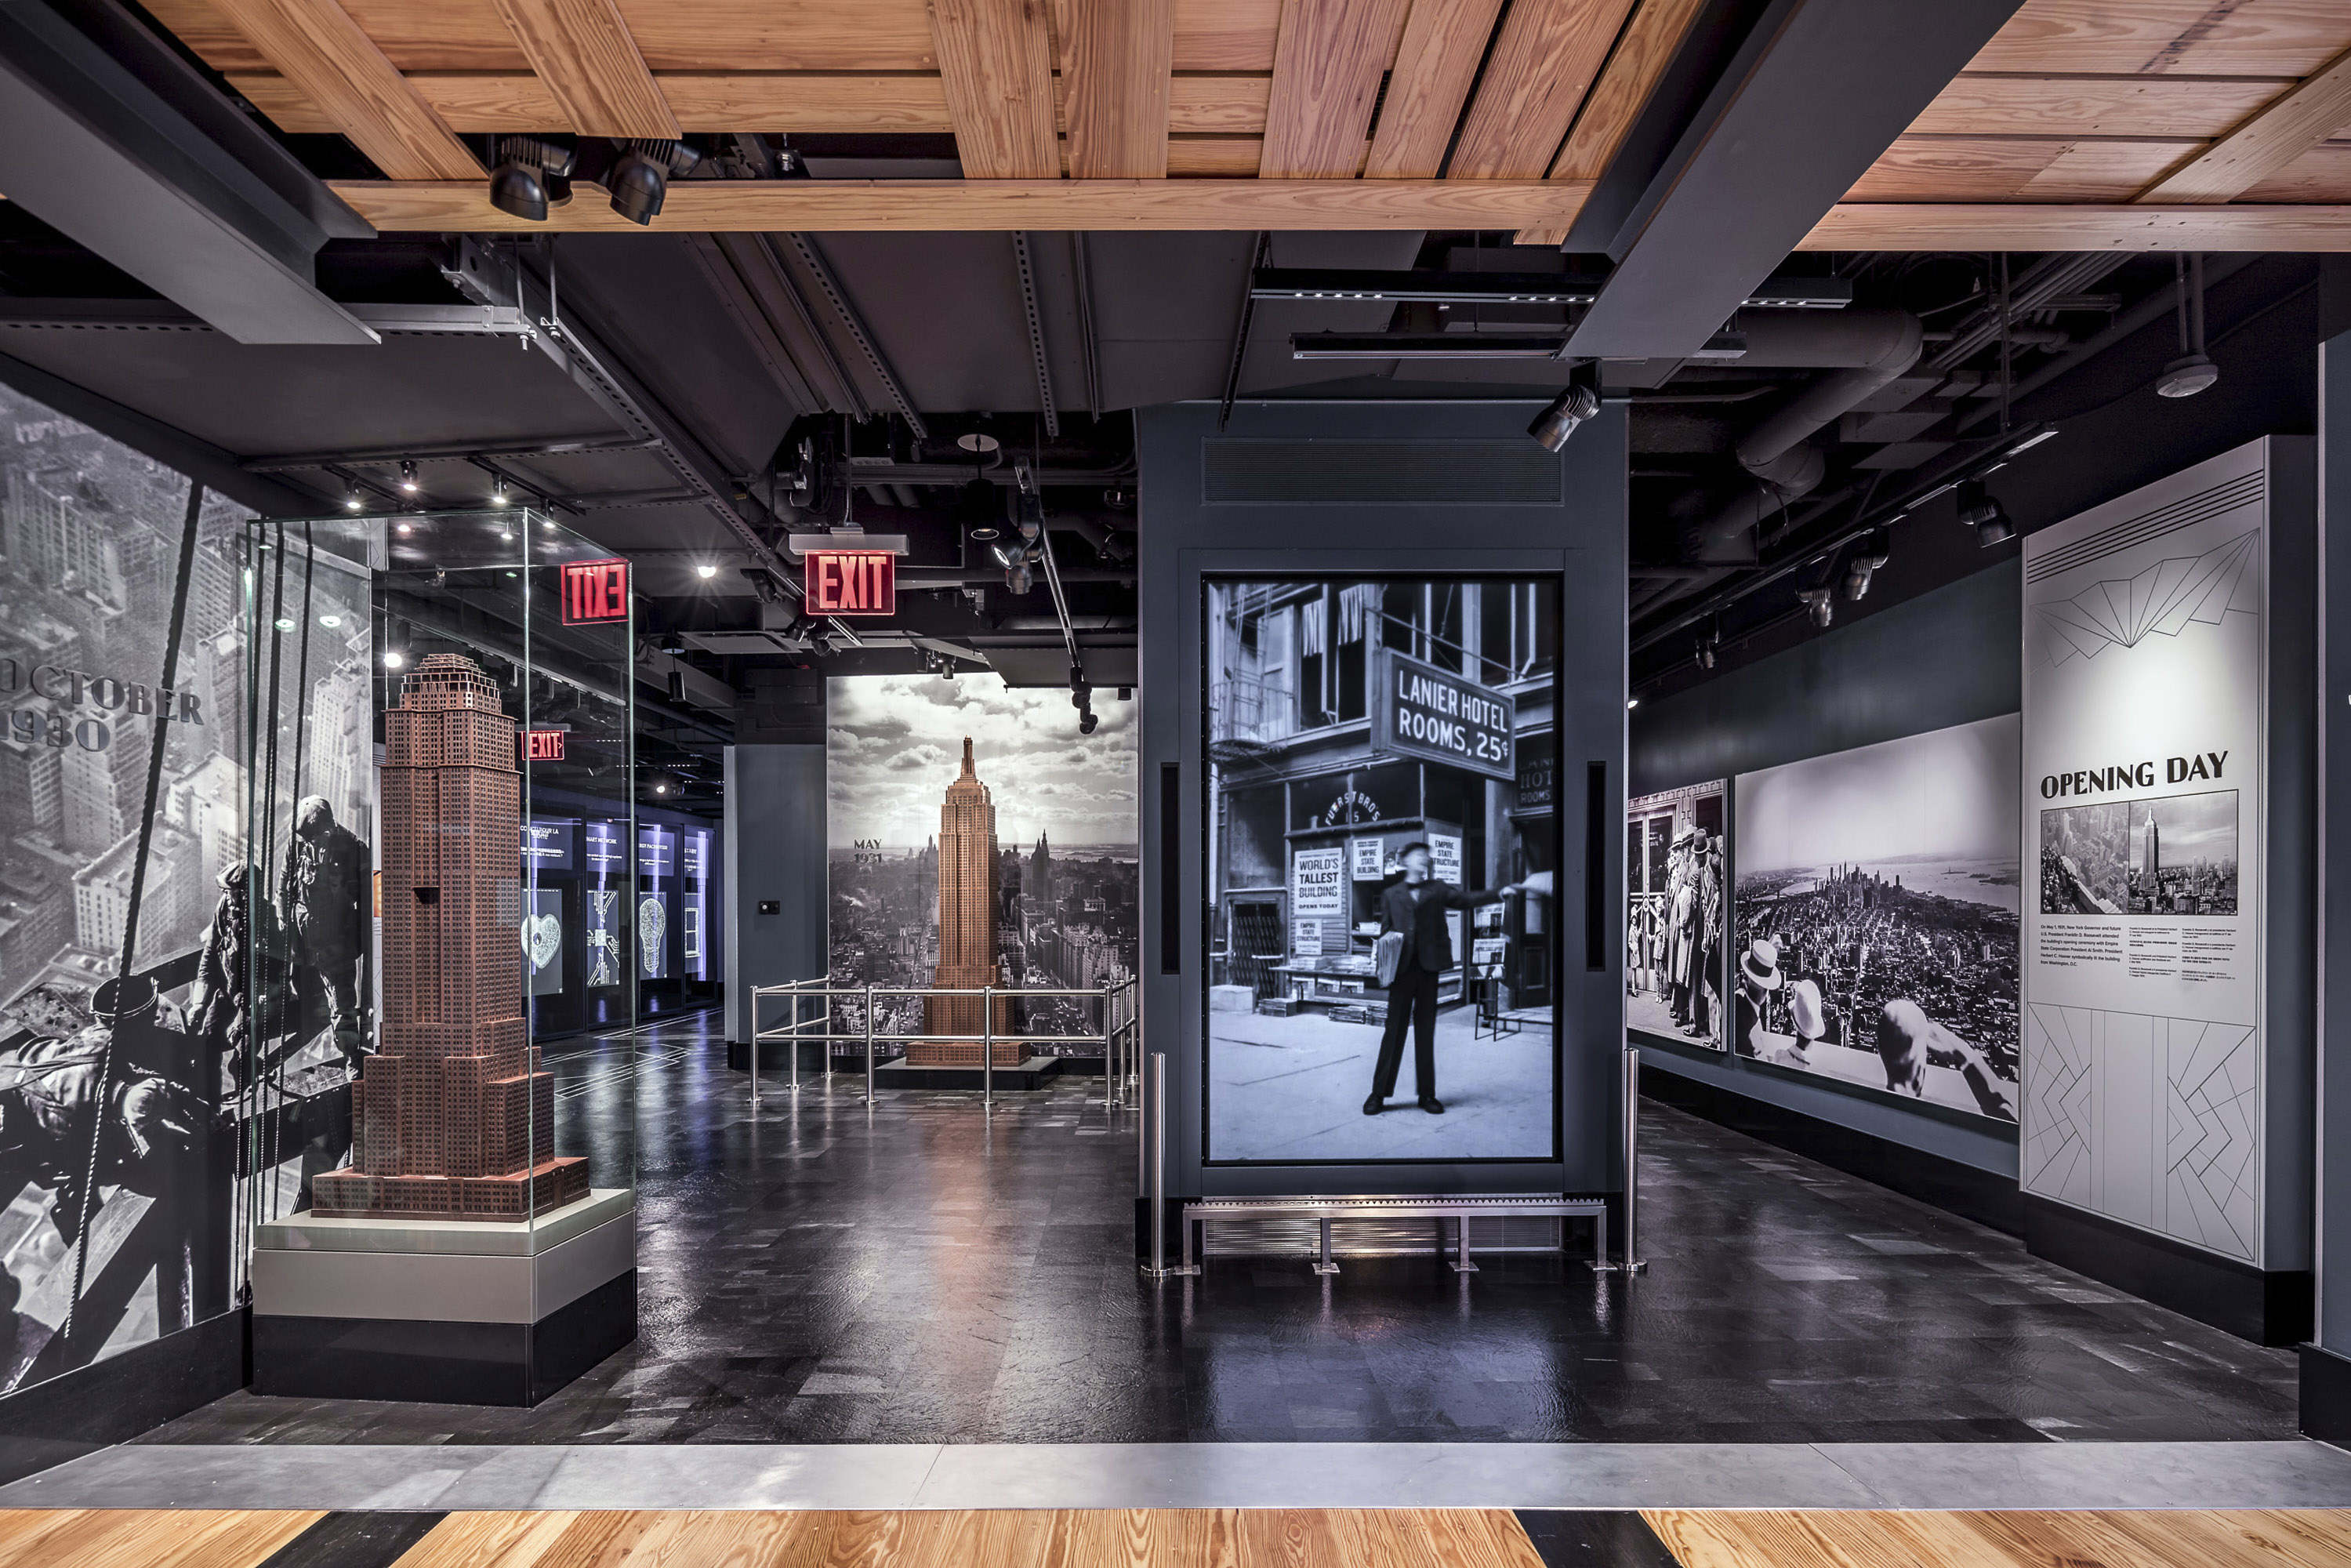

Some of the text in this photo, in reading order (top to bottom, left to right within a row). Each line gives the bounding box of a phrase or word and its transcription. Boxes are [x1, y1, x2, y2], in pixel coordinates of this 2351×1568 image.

[818, 555, 887, 610] EXIT
[0, 658, 205, 725] OCTOBER
[1399, 670, 1508, 733] LANIER HOTEL
[0, 710, 111, 752] 1930
[1399, 707, 1509, 761] ROOMS, 25¢
[529, 732, 560, 757] EXIT
[2041, 750, 2229, 800] OPENING DAY
[1521, 790, 1551, 804] ROOMS
[854, 839, 882, 850] MAY
[1435, 840, 1454, 849] EMPIRE
[854, 853, 882, 863] 1931
[1438, 850, 1453, 858] STATE
[1299, 858, 1338, 870] WORLD'S
[1433, 858, 1460, 867] TRUCTURE
[1299, 873, 1338, 884] TALLEST
[1299, 886, 1337, 898] BUILDING
